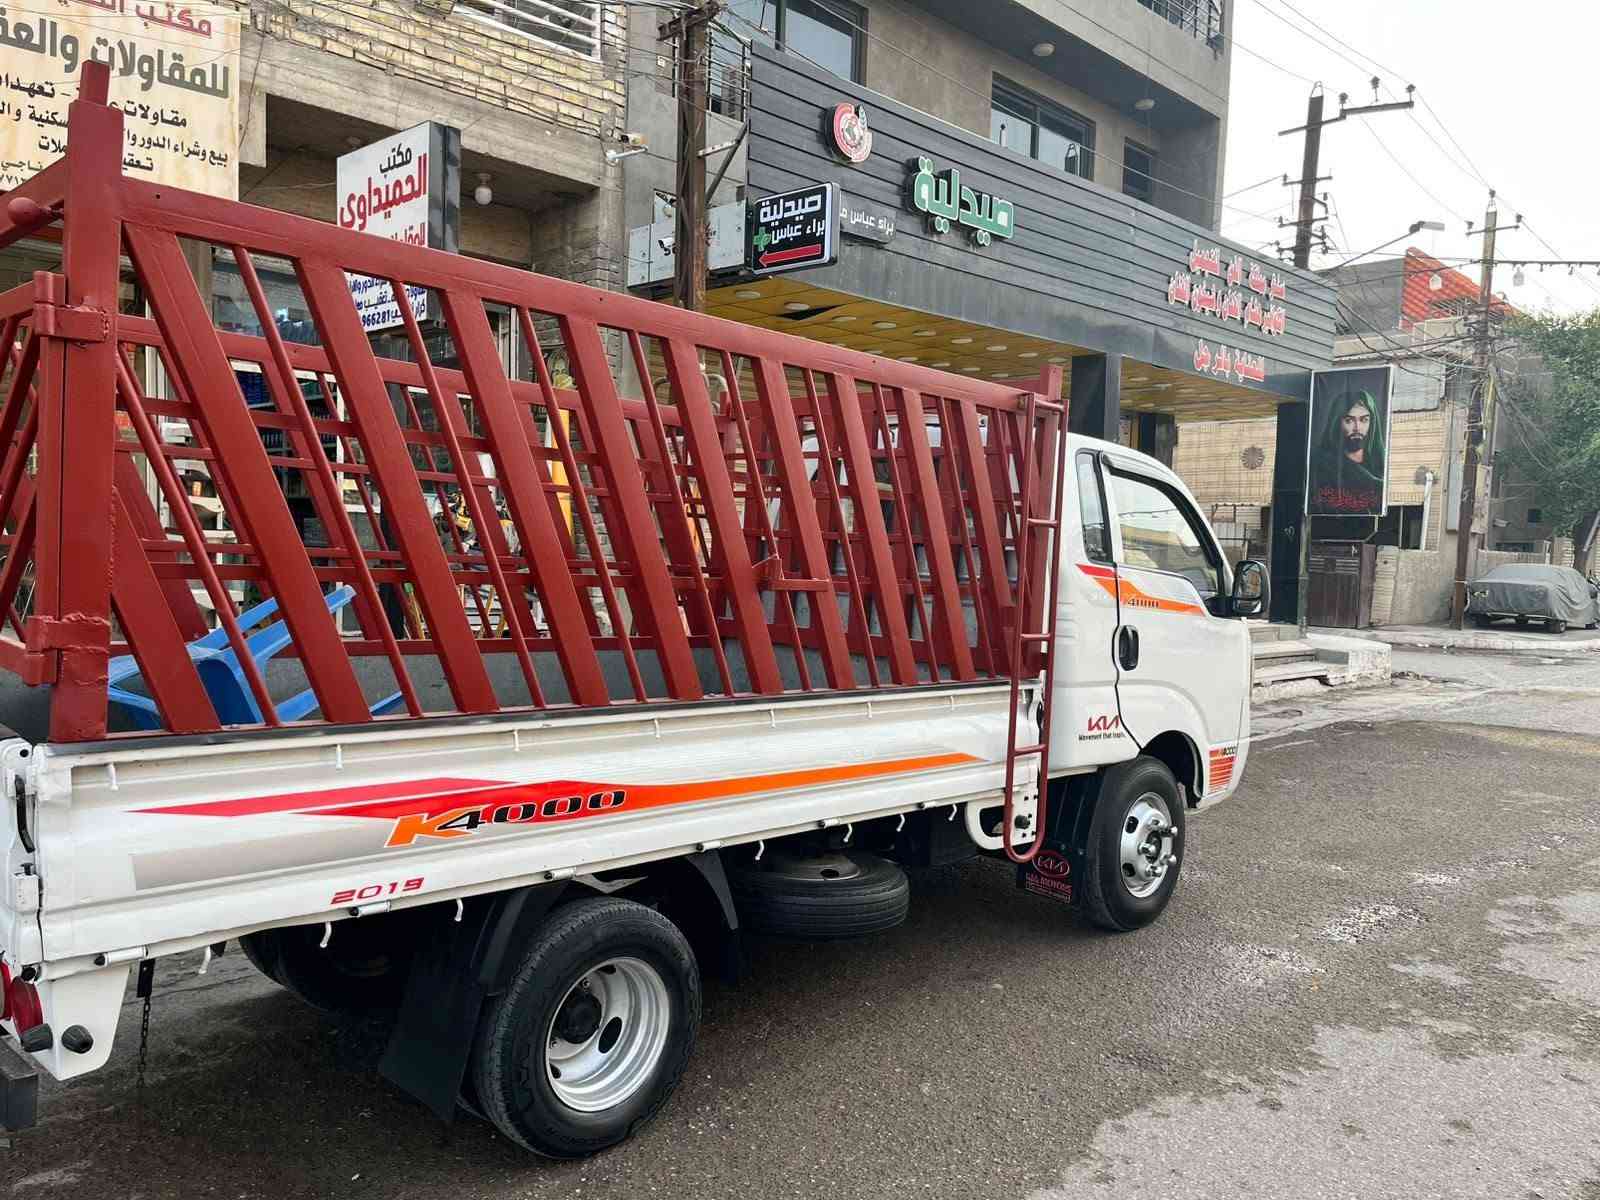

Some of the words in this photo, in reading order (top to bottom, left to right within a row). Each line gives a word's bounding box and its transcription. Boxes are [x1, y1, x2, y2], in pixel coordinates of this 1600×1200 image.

[136, 3, 212, 38] مكتب
[90, 36, 229, 99] للمقاولات
[0, 72, 55, 98] تعهدا
[28, 104, 69, 127] سكنية
[124, 100, 187, 127] مقاولات
[122, 152, 154, 171] تعقي
[174, 141, 207, 161] وشراء
[209, 149, 228, 168] بيع
[379, 143, 412, 178] مكتب
[760, 194, 822, 227] صيدلية
[913, 156, 1014, 247] صيدلية
[805, 218, 825, 237] براء
[850, 210, 876, 229] عباس
[771, 224, 802, 245] عباس
[361, 309, 390, 327] 966281
[1087, 714, 1120, 731] KIA
[384, 789, 627, 848] K4000
[330, 877, 425, 904] 2019
